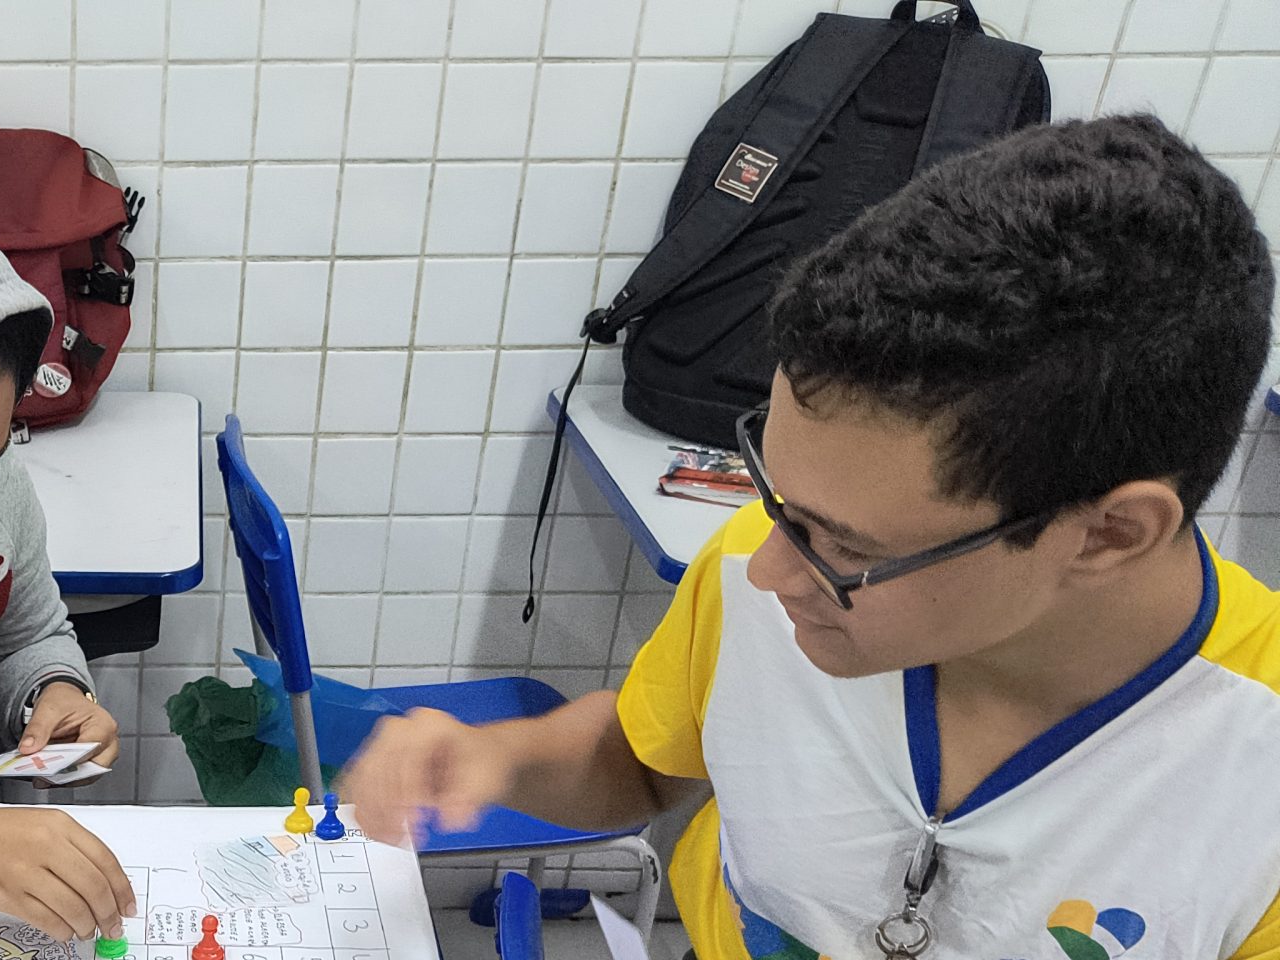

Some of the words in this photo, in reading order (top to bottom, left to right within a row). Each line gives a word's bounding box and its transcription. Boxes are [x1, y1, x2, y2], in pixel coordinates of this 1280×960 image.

[329, 849, 356, 864] 1
[337, 883, 357, 894] 2
[342, 919, 369, 933] 3
